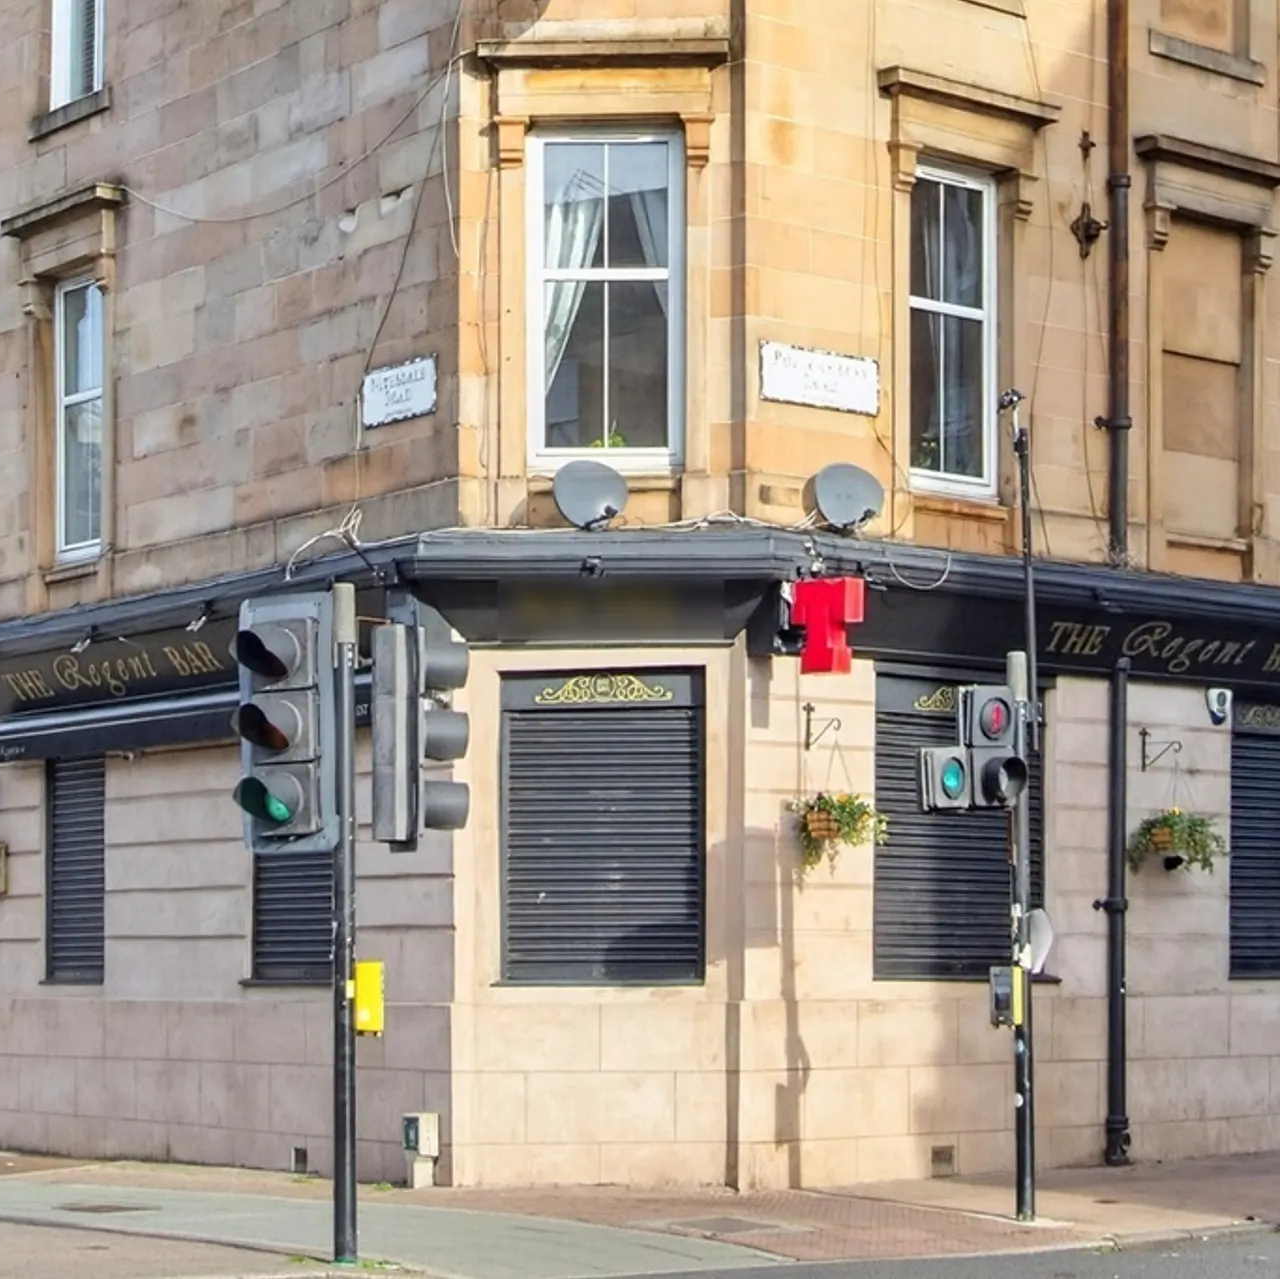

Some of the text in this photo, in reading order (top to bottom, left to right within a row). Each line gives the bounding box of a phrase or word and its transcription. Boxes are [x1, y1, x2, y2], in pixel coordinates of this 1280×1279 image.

[2, 641, 225, 701] THE Regent BAR
[1045, 621, 1110, 655] THE
[1122, 621, 1256, 673] Regent
